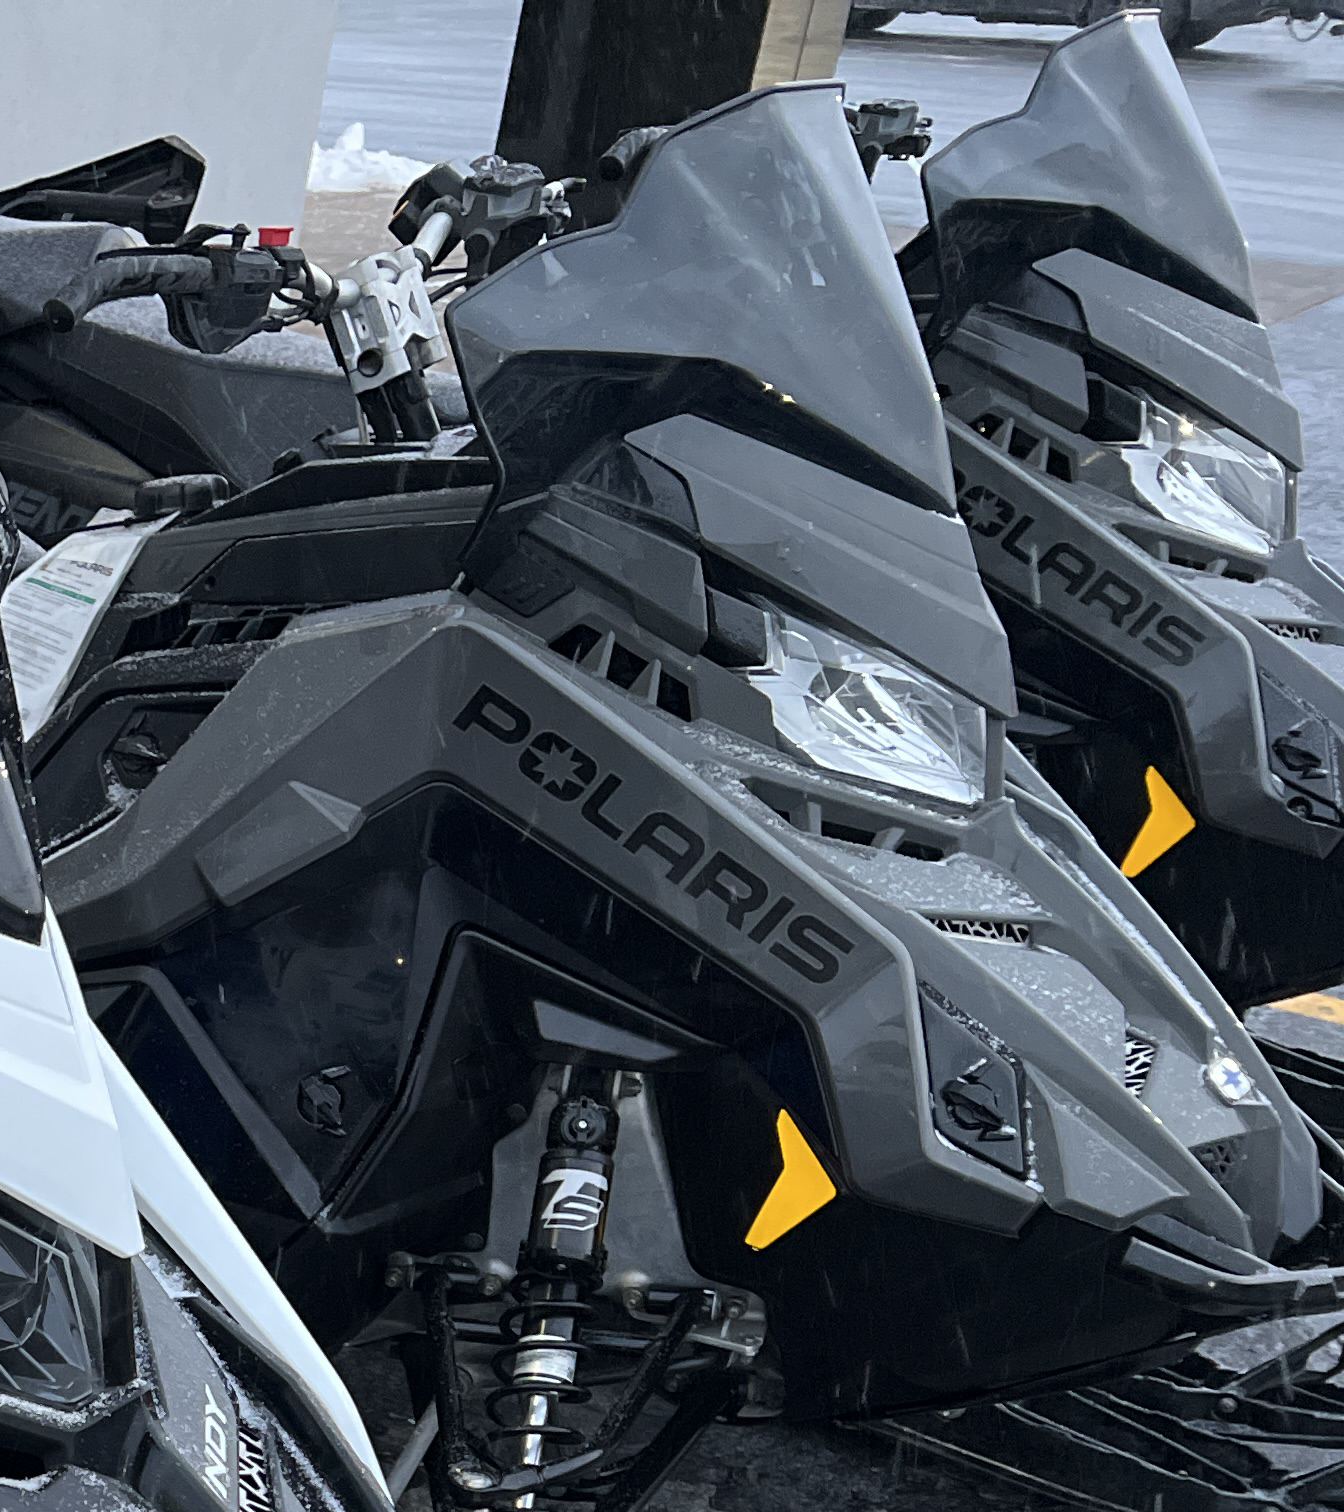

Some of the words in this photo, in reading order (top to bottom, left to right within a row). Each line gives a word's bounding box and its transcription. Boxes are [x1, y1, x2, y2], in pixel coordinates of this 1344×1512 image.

[955, 467, 1207, 666] OLARIS
[452, 683, 856, 984] POLARIS
[202, 1383, 227, 1501] INDY
